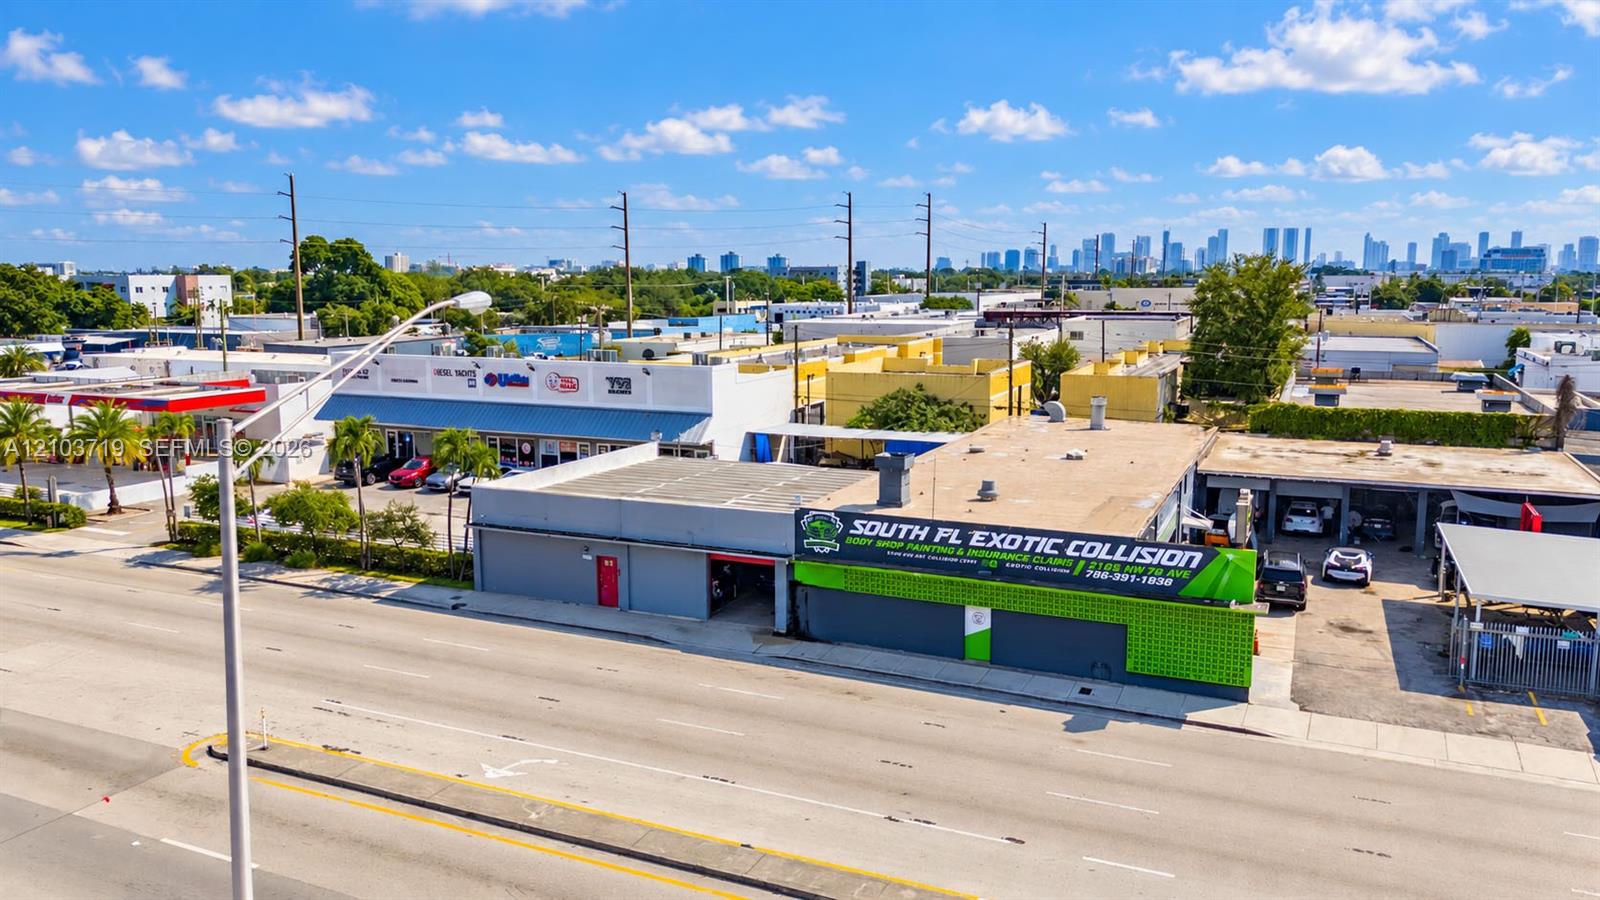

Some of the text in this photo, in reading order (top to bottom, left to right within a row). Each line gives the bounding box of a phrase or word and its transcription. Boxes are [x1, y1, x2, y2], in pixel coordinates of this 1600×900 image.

[845, 536, 873, 546] BODY
[875, 540, 904, 549] SHOP
[906, 543, 955, 555] PAINTING
[956, 548, 964, 556] &
[966, 548, 1031, 562] INSURANCE
[1032, 555, 1074, 567] CLAIMS
[849, 519, 1203, 568] SOUTH FL EXOTIC COLLISION
[1124, 565, 1146, 574] NW
[1166, 569, 1192, 579] AVE
